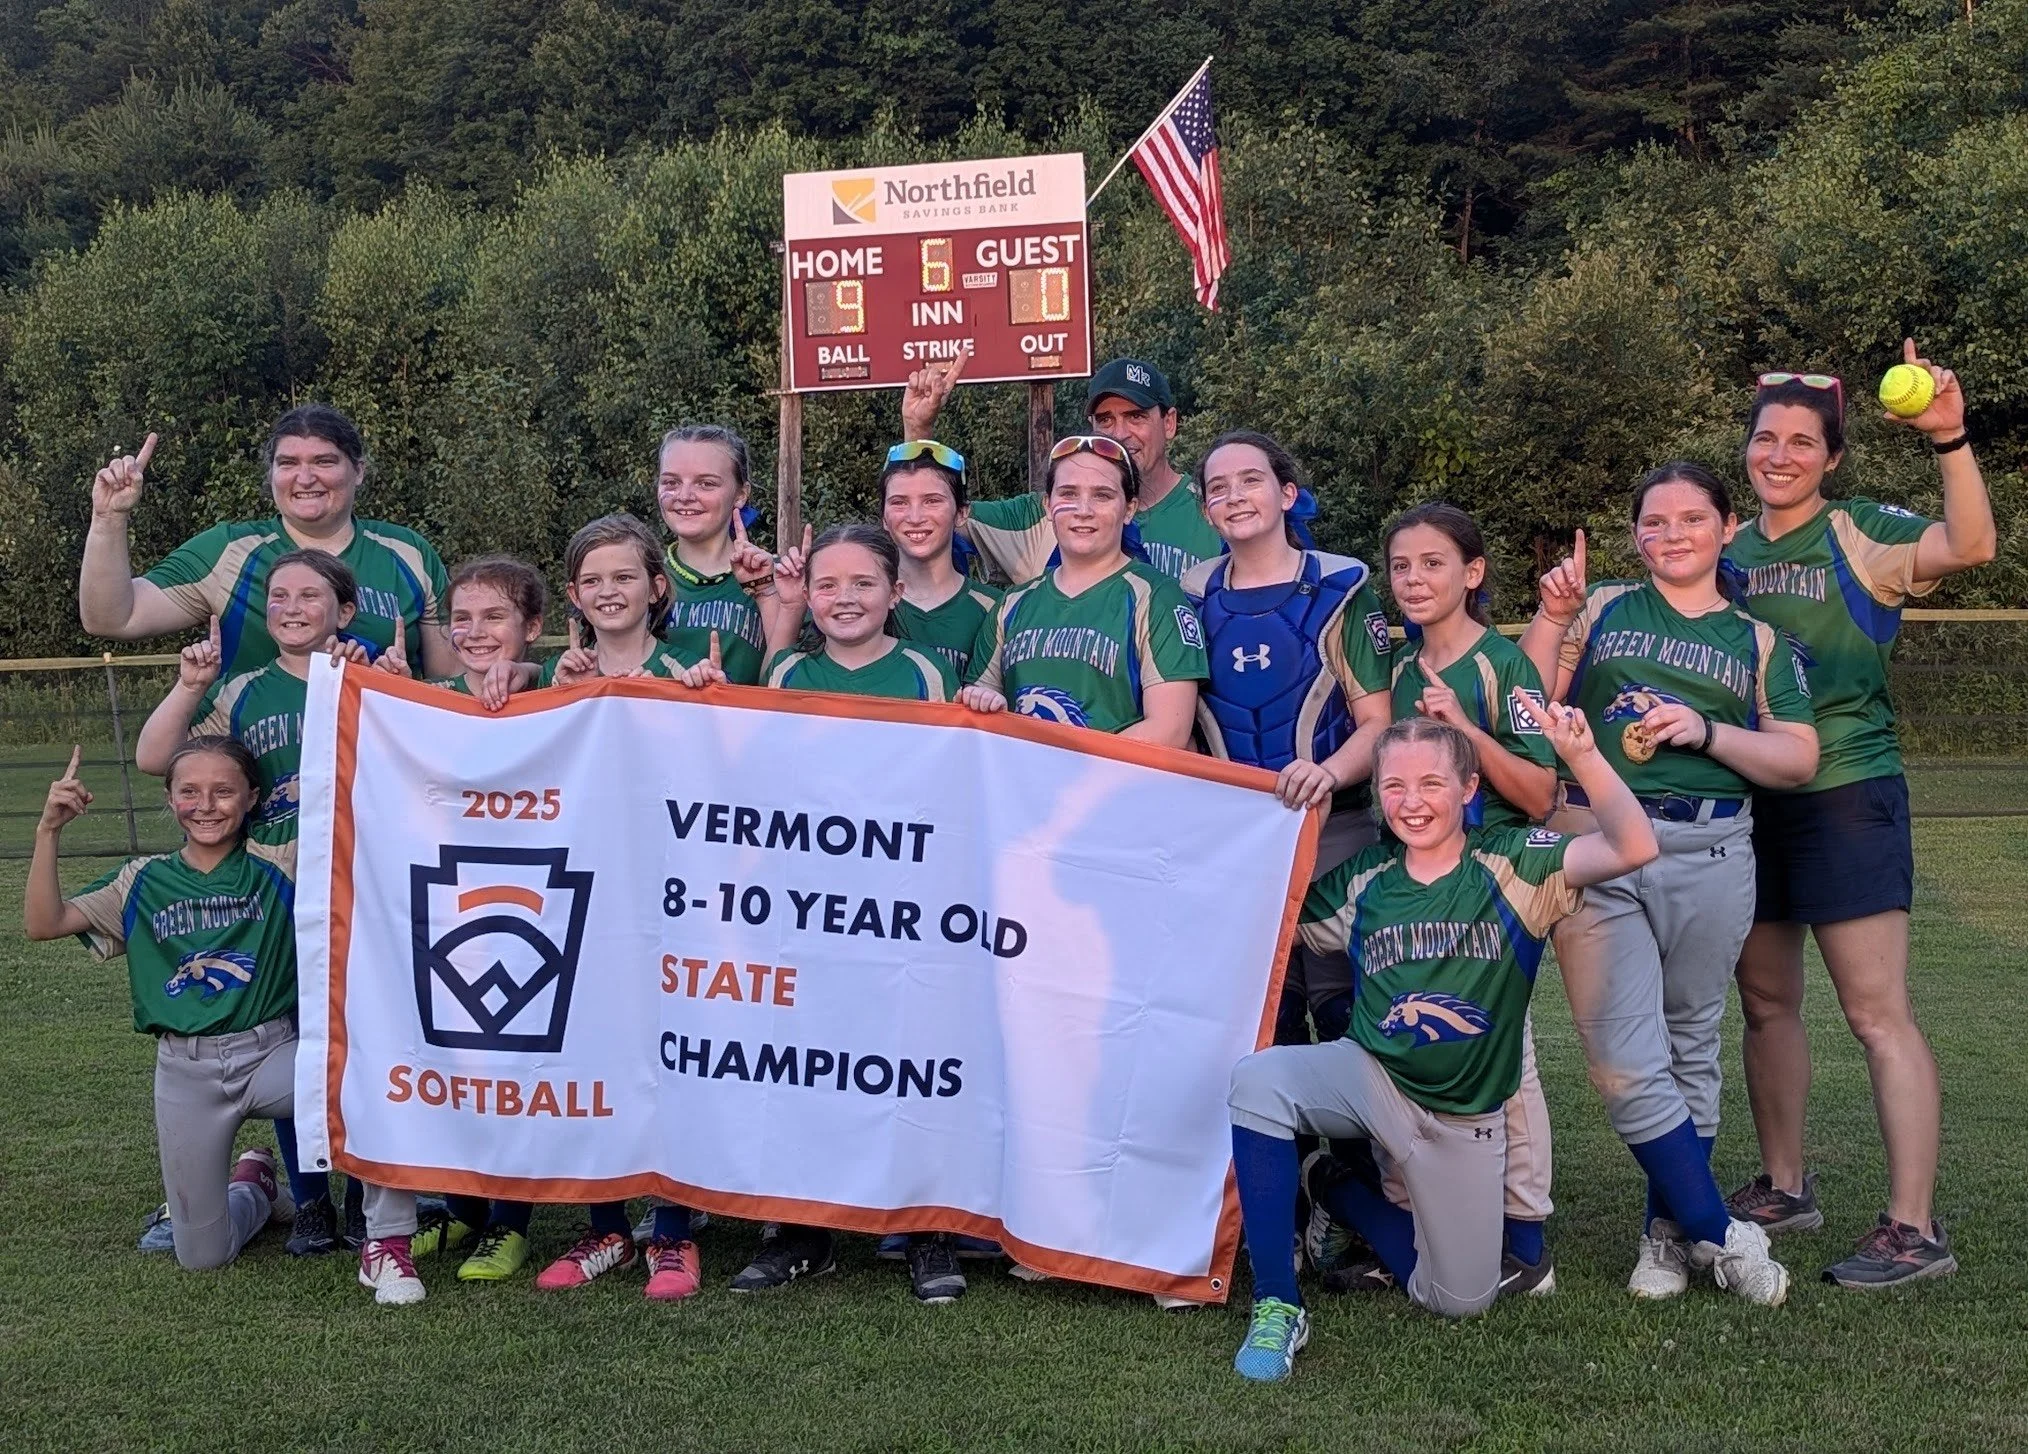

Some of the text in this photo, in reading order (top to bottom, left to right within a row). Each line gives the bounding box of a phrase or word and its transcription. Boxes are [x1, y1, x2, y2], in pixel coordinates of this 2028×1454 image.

[884, 169, 1037, 206] Northfield
[903, 203, 1019, 219] SAVINGS BANK
[792, 247, 884, 279] HOME
[921, 238, 950, 292] 6
[976, 235, 1081, 267] GUEST
[964, 274, 996, 284] VARSITY
[1040, 267, 1069, 321] 0
[836, 280, 864, 333] 9
[911, 300, 963, 326] INN
[818, 345, 870, 364] BALL
[903, 338, 974, 360] STRIKE
[1020, 333, 1068, 354] OUT
[1745, 562, 1826, 602] MOUNTAIN
[1041, 627, 1119, 678] MOUNTAIN
[1593, 630, 1751, 702] GREEN MOUNTAIN
[461, 788, 561, 821] 2025
[665, 799, 934, 863] VERMONT
[153, 899, 195, 944] GREEN
[663, 878, 1028, 959] 8-10 YEAR OLD
[1363, 921, 1502, 977] GREEN MOUNTAIN
[661, 953, 797, 1006] STATE
[660, 1031, 963, 1098] CHAMPIONS
[386, 1065, 614, 1119] SOFTBALL
[580, 1241, 625, 1280] NIKE
